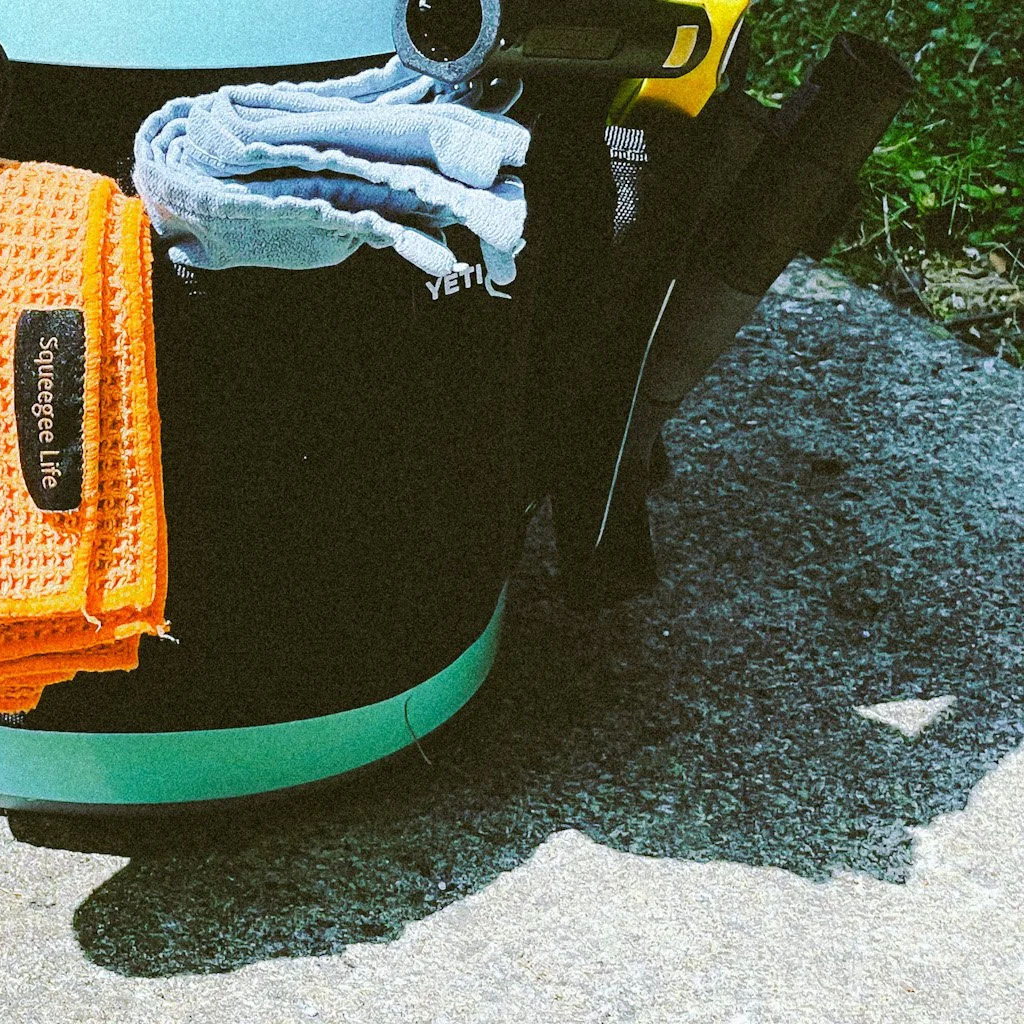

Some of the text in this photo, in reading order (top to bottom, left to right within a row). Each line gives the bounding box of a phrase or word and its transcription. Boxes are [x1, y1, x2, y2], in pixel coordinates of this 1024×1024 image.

[425, 263, 483, 300] YETI
[31, 336, 62, 489] Squeegee Life
